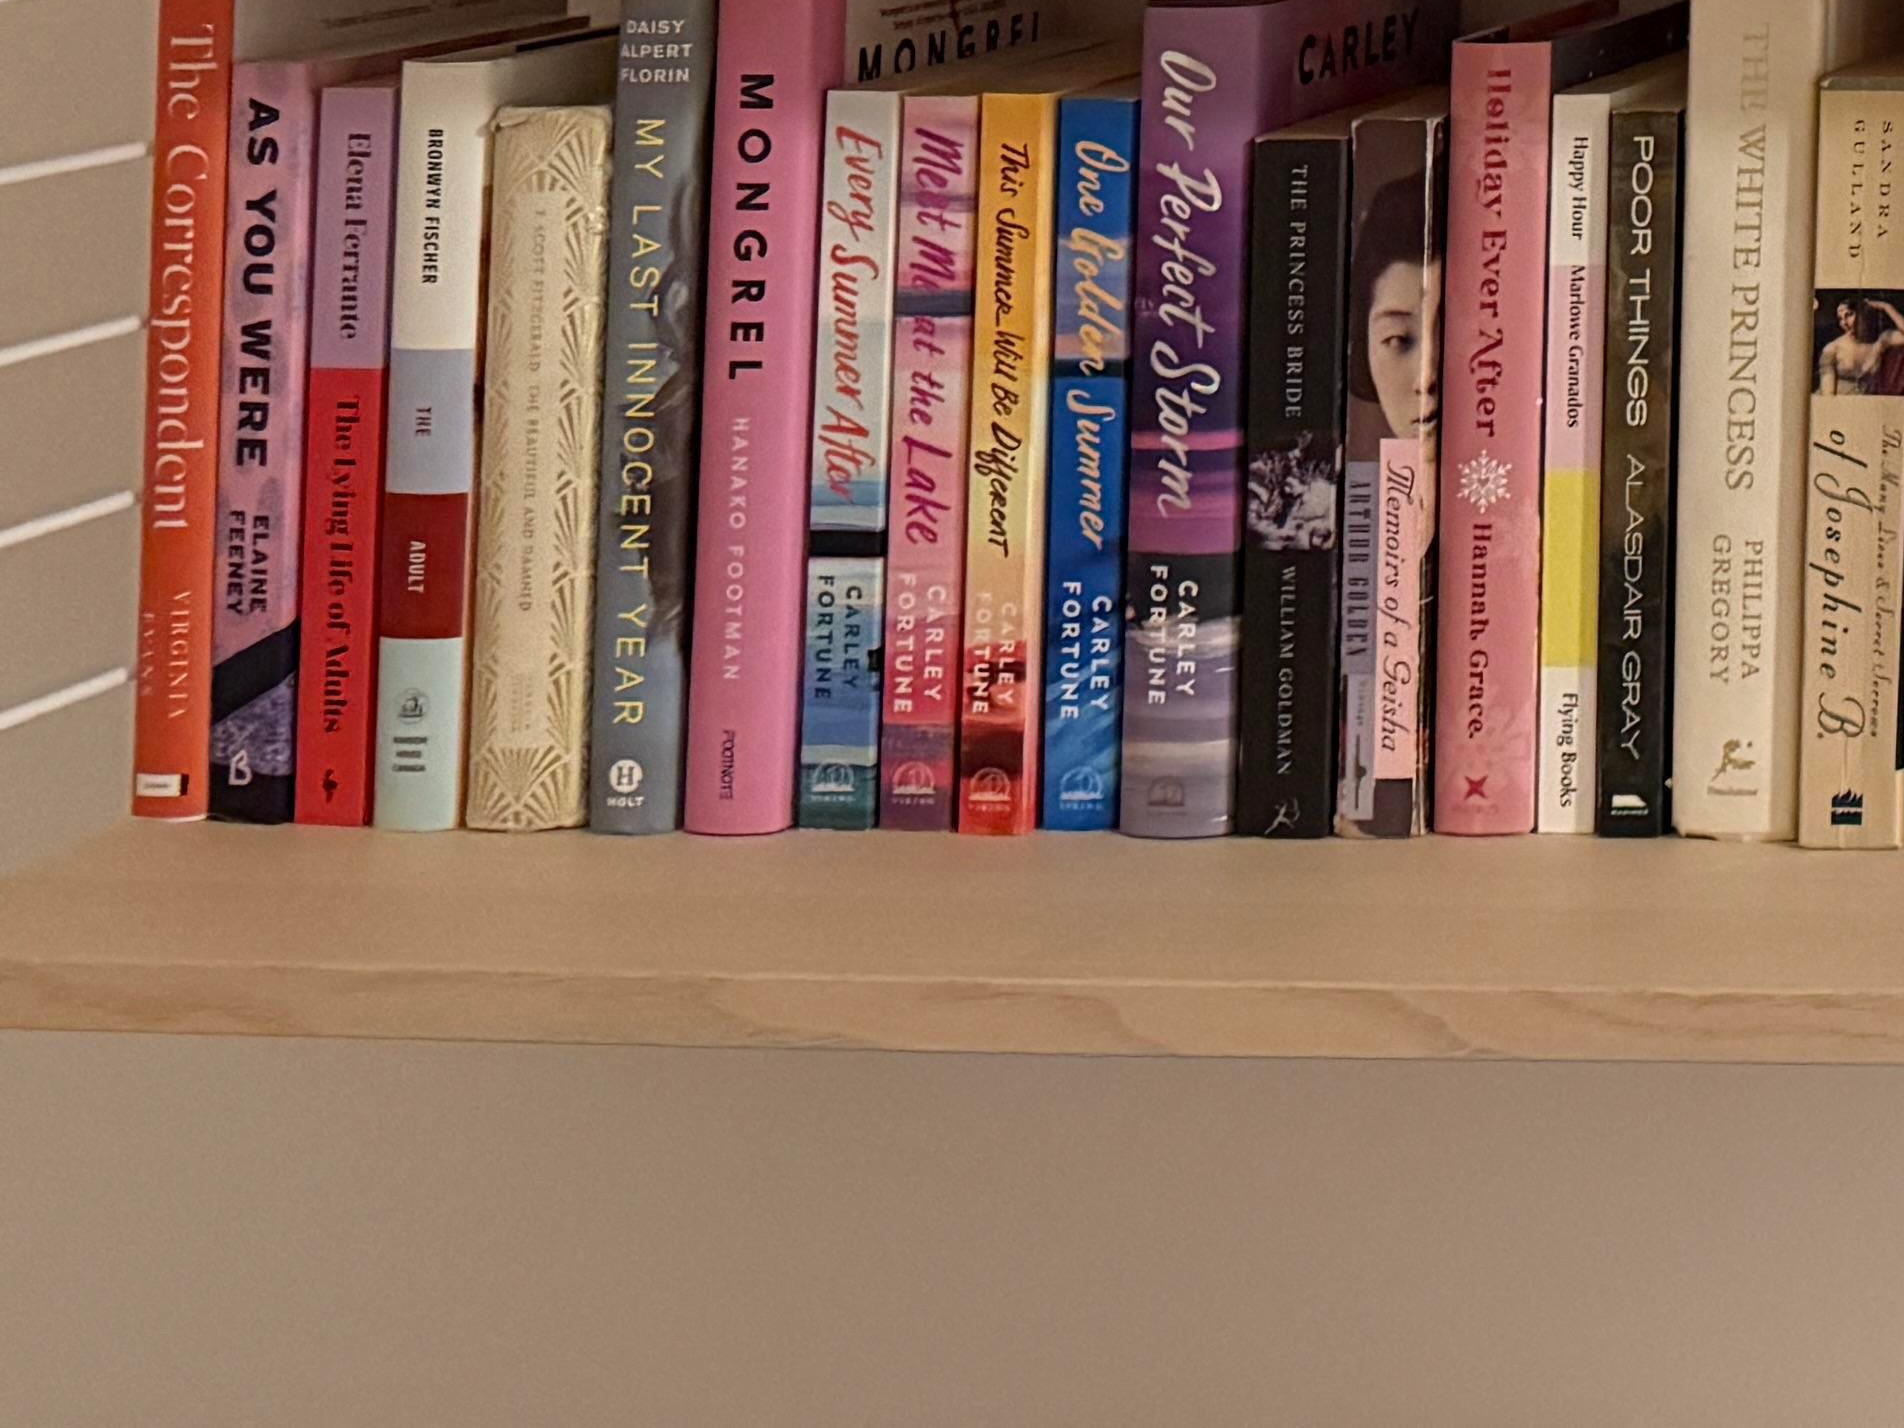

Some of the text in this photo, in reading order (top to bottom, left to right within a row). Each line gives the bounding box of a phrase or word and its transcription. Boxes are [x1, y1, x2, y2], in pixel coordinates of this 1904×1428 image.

[620, 43, 693, 60] ALPERT
[620, 67, 692, 83] FLORIN
[626, 19, 686, 36] DAISY
[421, 126, 446, 286] BRONWYN FISCHER
[728, 71, 776, 381] MONGREL
[721, 416, 750, 682] HANAKO FOOTMAN
[1060, 580, 1081, 721] FORTUNE
[1089, 594, 1113, 711] CARLEY
